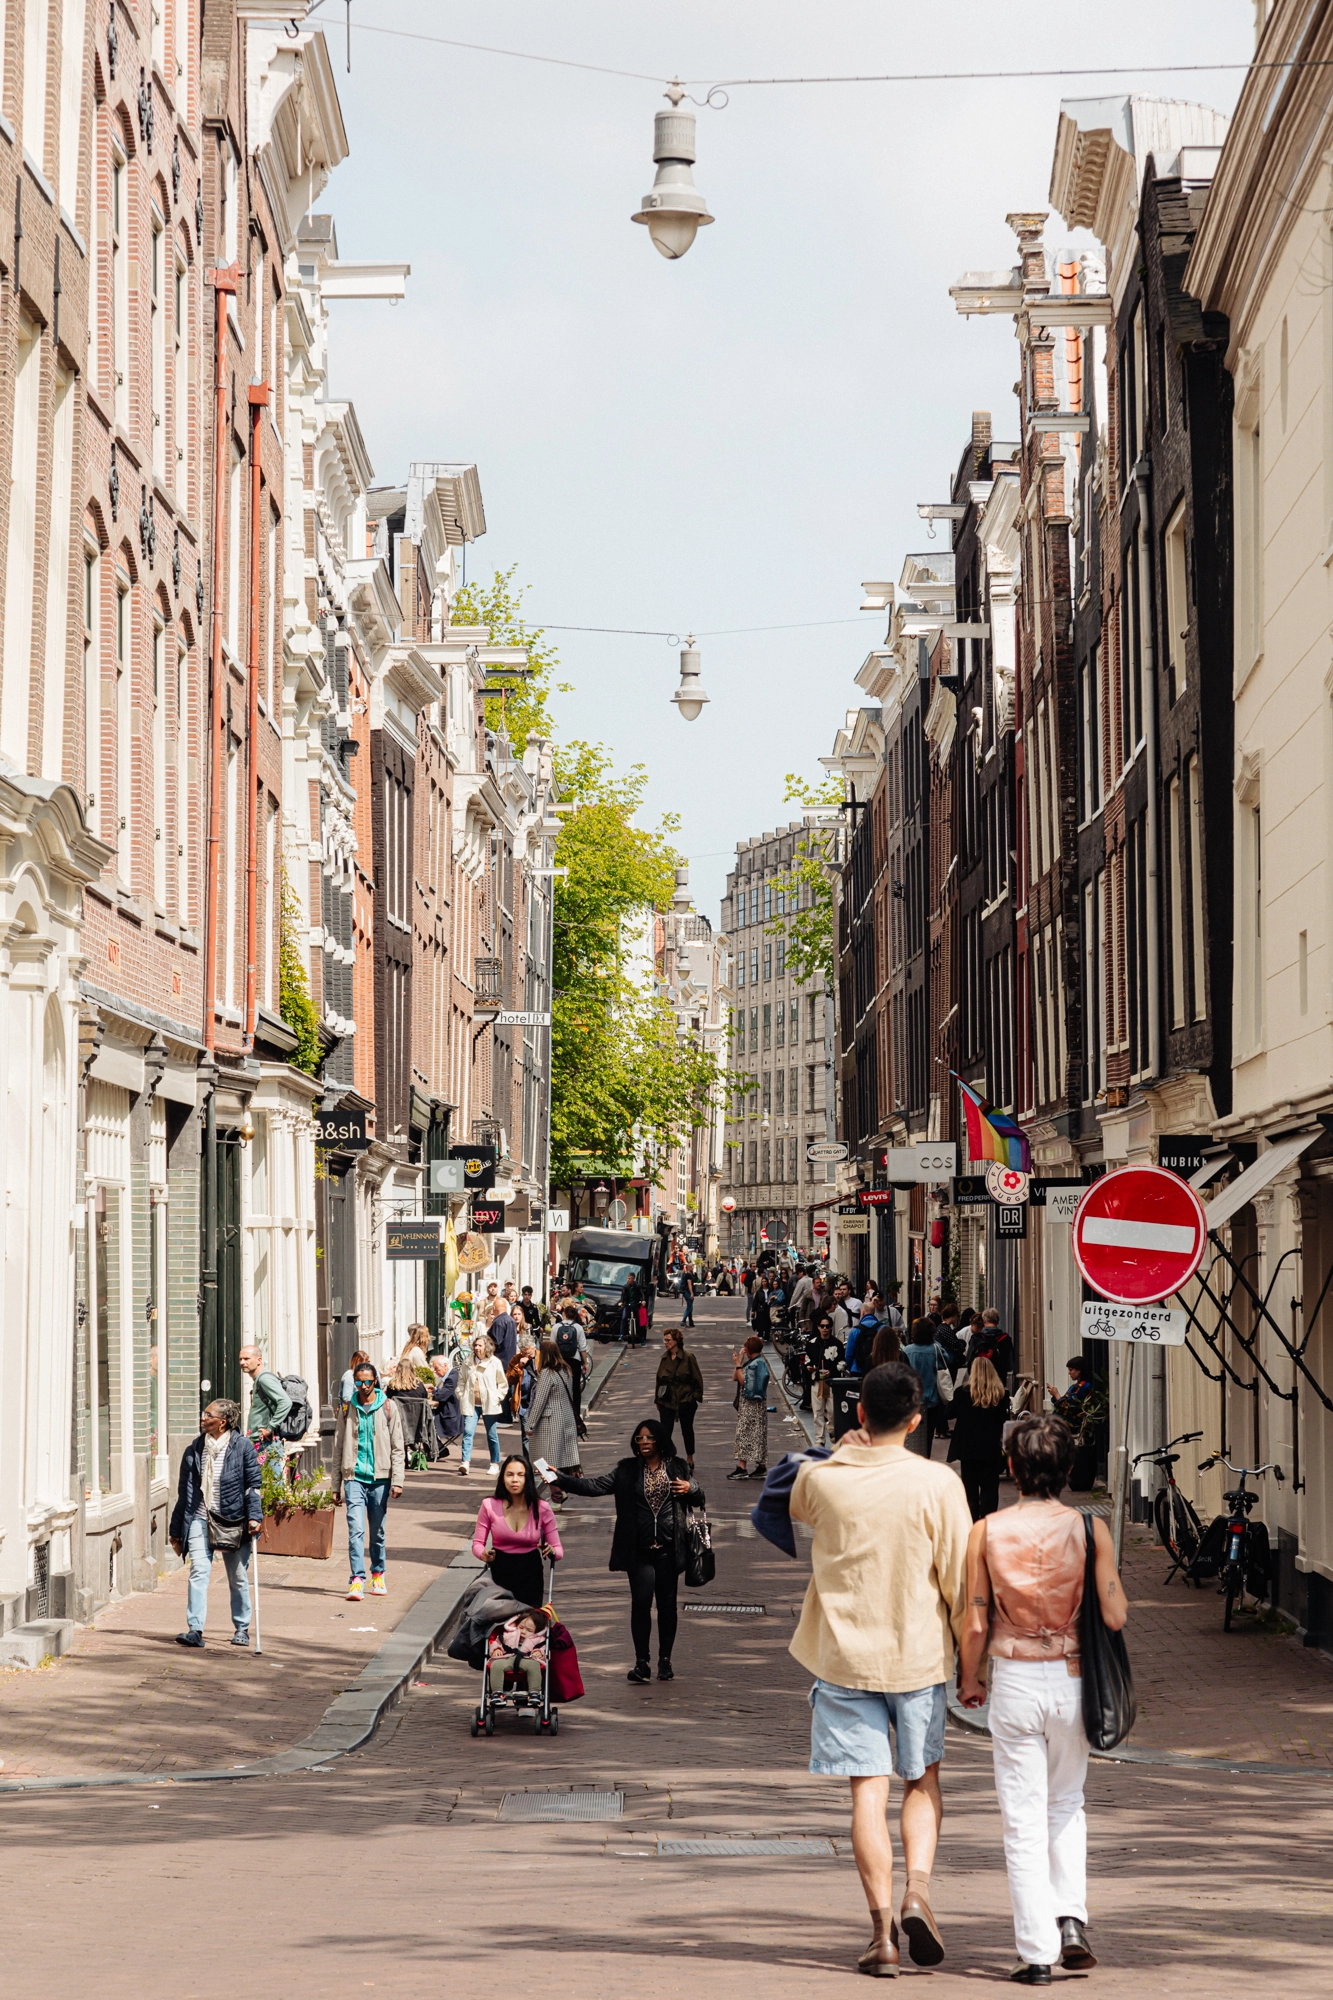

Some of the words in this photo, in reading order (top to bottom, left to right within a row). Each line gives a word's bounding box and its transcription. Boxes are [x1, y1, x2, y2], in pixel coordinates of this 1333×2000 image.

[500, 1012, 530, 1024] hotel
[533, 1013, 545, 1024] IX
[315, 1121, 361, 1140] a&sh
[919, 1156, 953, 1169] COS
[1051, 1194, 1082, 1205] AMERI
[474, 1210, 499, 1225] my
[1003, 1209, 1020, 1224] DR
[1083, 1305, 1172, 1322] uitgezonderd
